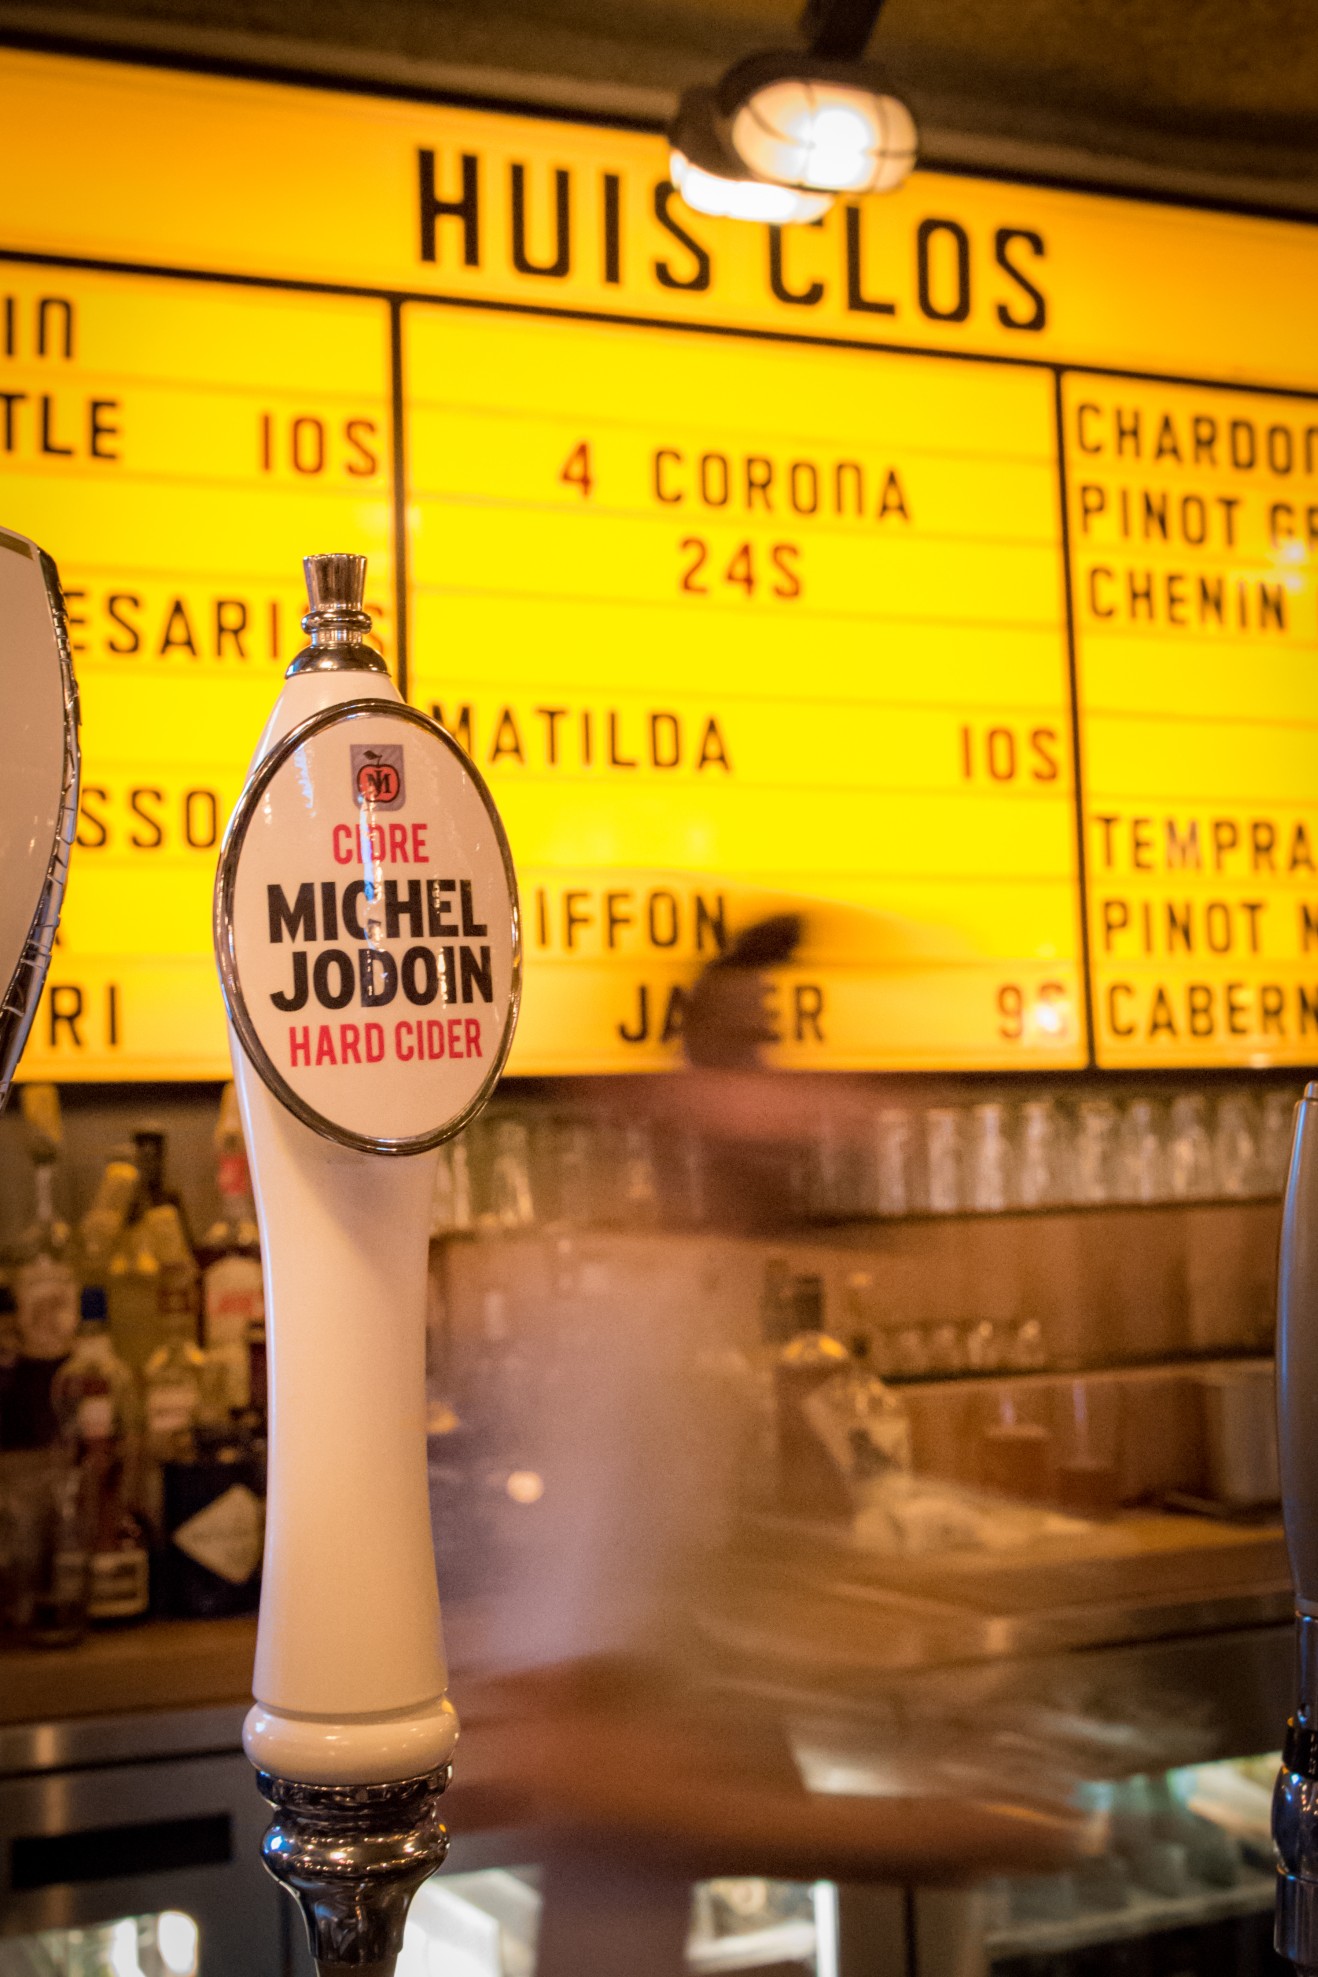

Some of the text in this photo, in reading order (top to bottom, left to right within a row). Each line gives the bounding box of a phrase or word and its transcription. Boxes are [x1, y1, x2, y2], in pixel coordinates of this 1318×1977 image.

[417, 147, 1048, 331] HUIS CLOS
[0, 391, 118, 459] TLE
[560, 442, 592, 498] 4
[1081, 485, 1242, 547] PINOT
[679, 537, 802, 599] 24S
[1090, 567, 1288, 630] CHENIN
[332, 824, 429, 865] CIDRE
[1095, 816, 1318, 872] TEMPRA
[266, 879, 488, 944] MICHEL
[537, 887, 727, 951] IFFON
[1103, 900, 1264, 954] PINOT
[269, 945, 494, 1013] JODOIN
[50, 985, 117, 1047] RI
[618, 985, 824, 1043] JAER
[1109, 983, 1318, 1038] CABERN
[289, 1018, 484, 1067] HARD CIDER
